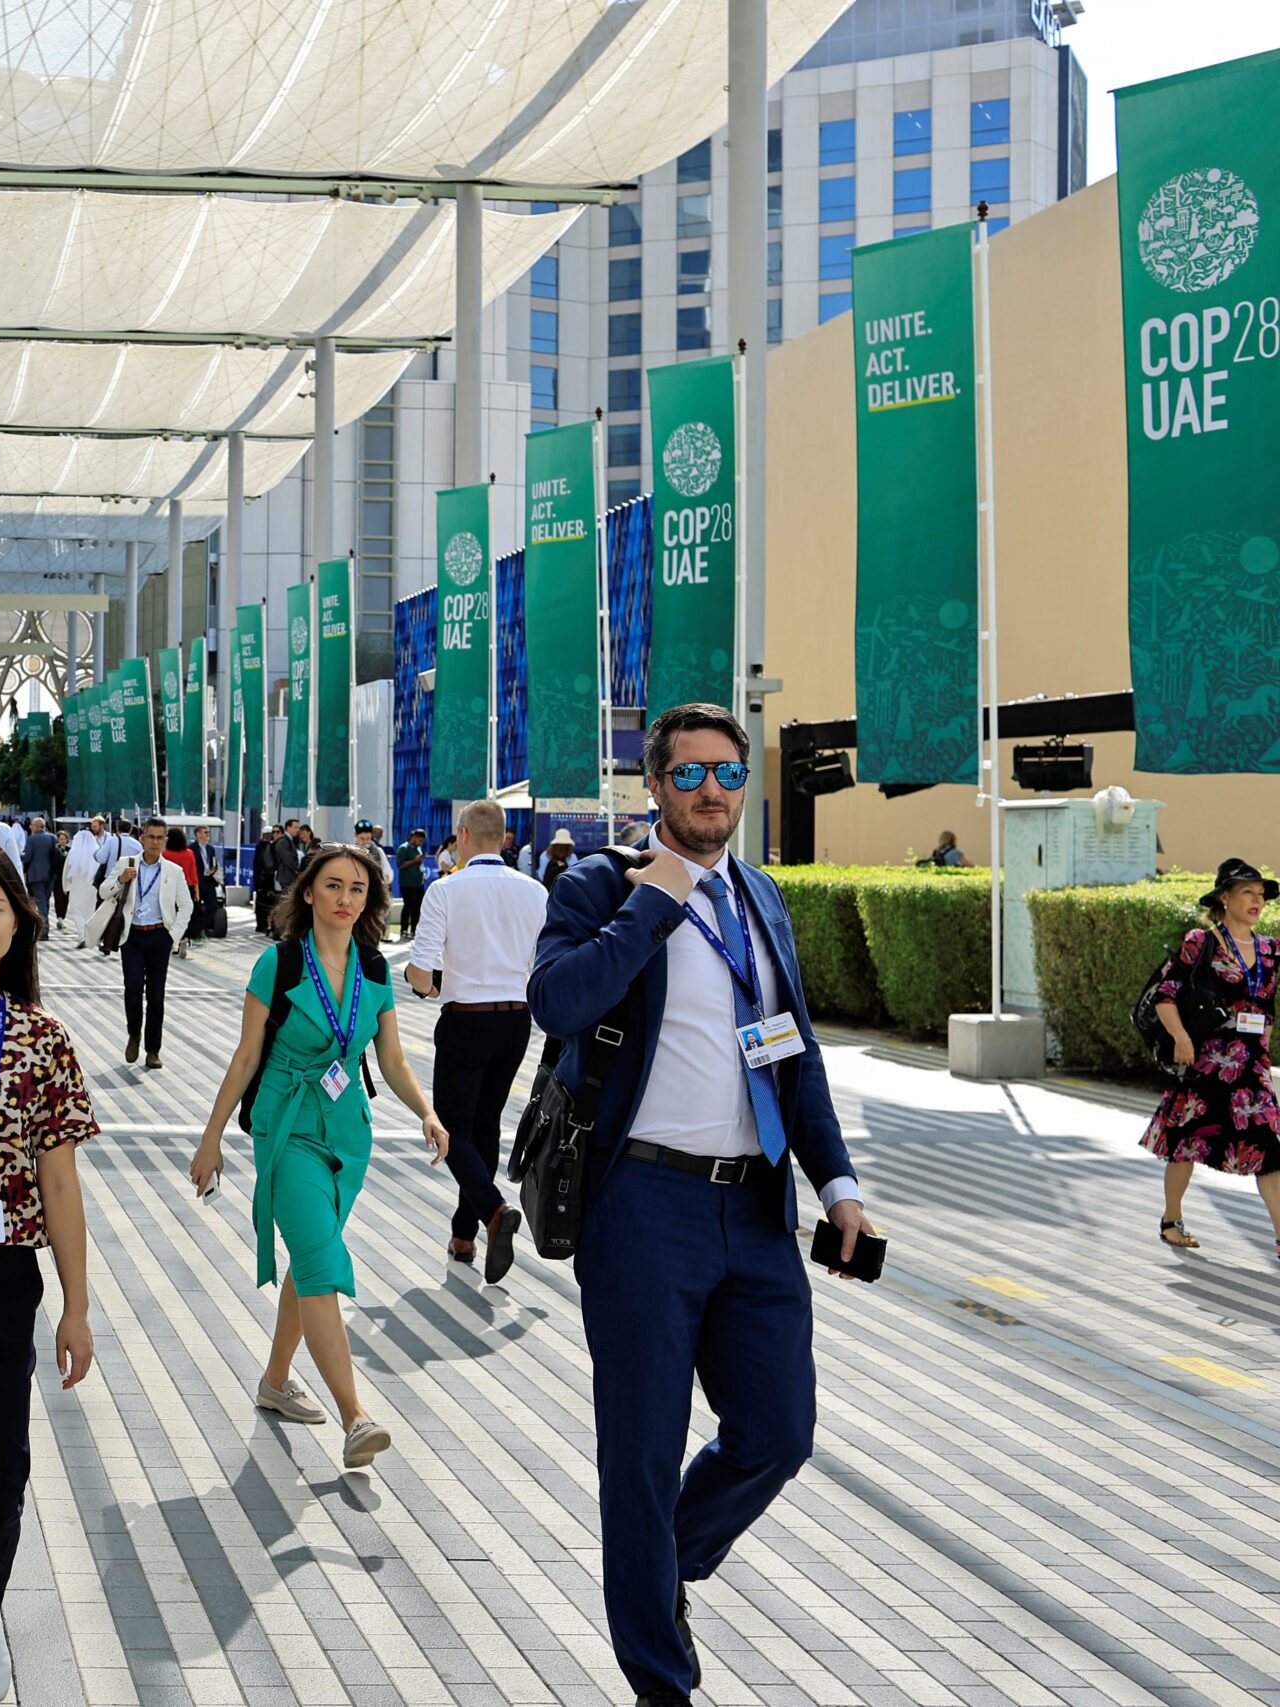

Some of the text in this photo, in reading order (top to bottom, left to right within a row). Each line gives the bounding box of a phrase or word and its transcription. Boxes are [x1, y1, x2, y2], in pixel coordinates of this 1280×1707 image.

[865, 310, 933, 346] UNITE.
[1140, 296, 1280, 377] COP28
[865, 347, 910, 378] ACT.
[867, 371, 961, 408] DELIVER.
[1141, 369, 1229, 441] UAE
[531, 478, 571, 500] UNITE.
[531, 501, 556, 521] ACT.
[663, 502, 732, 547] COP28
[531, 519, 588, 542] DELIVER.
[662, 546, 710, 587] UAE
[322, 594, 340, 609] UNITE.
[444, 591, 489, 622] COP28
[443, 622, 473, 650] UAE
